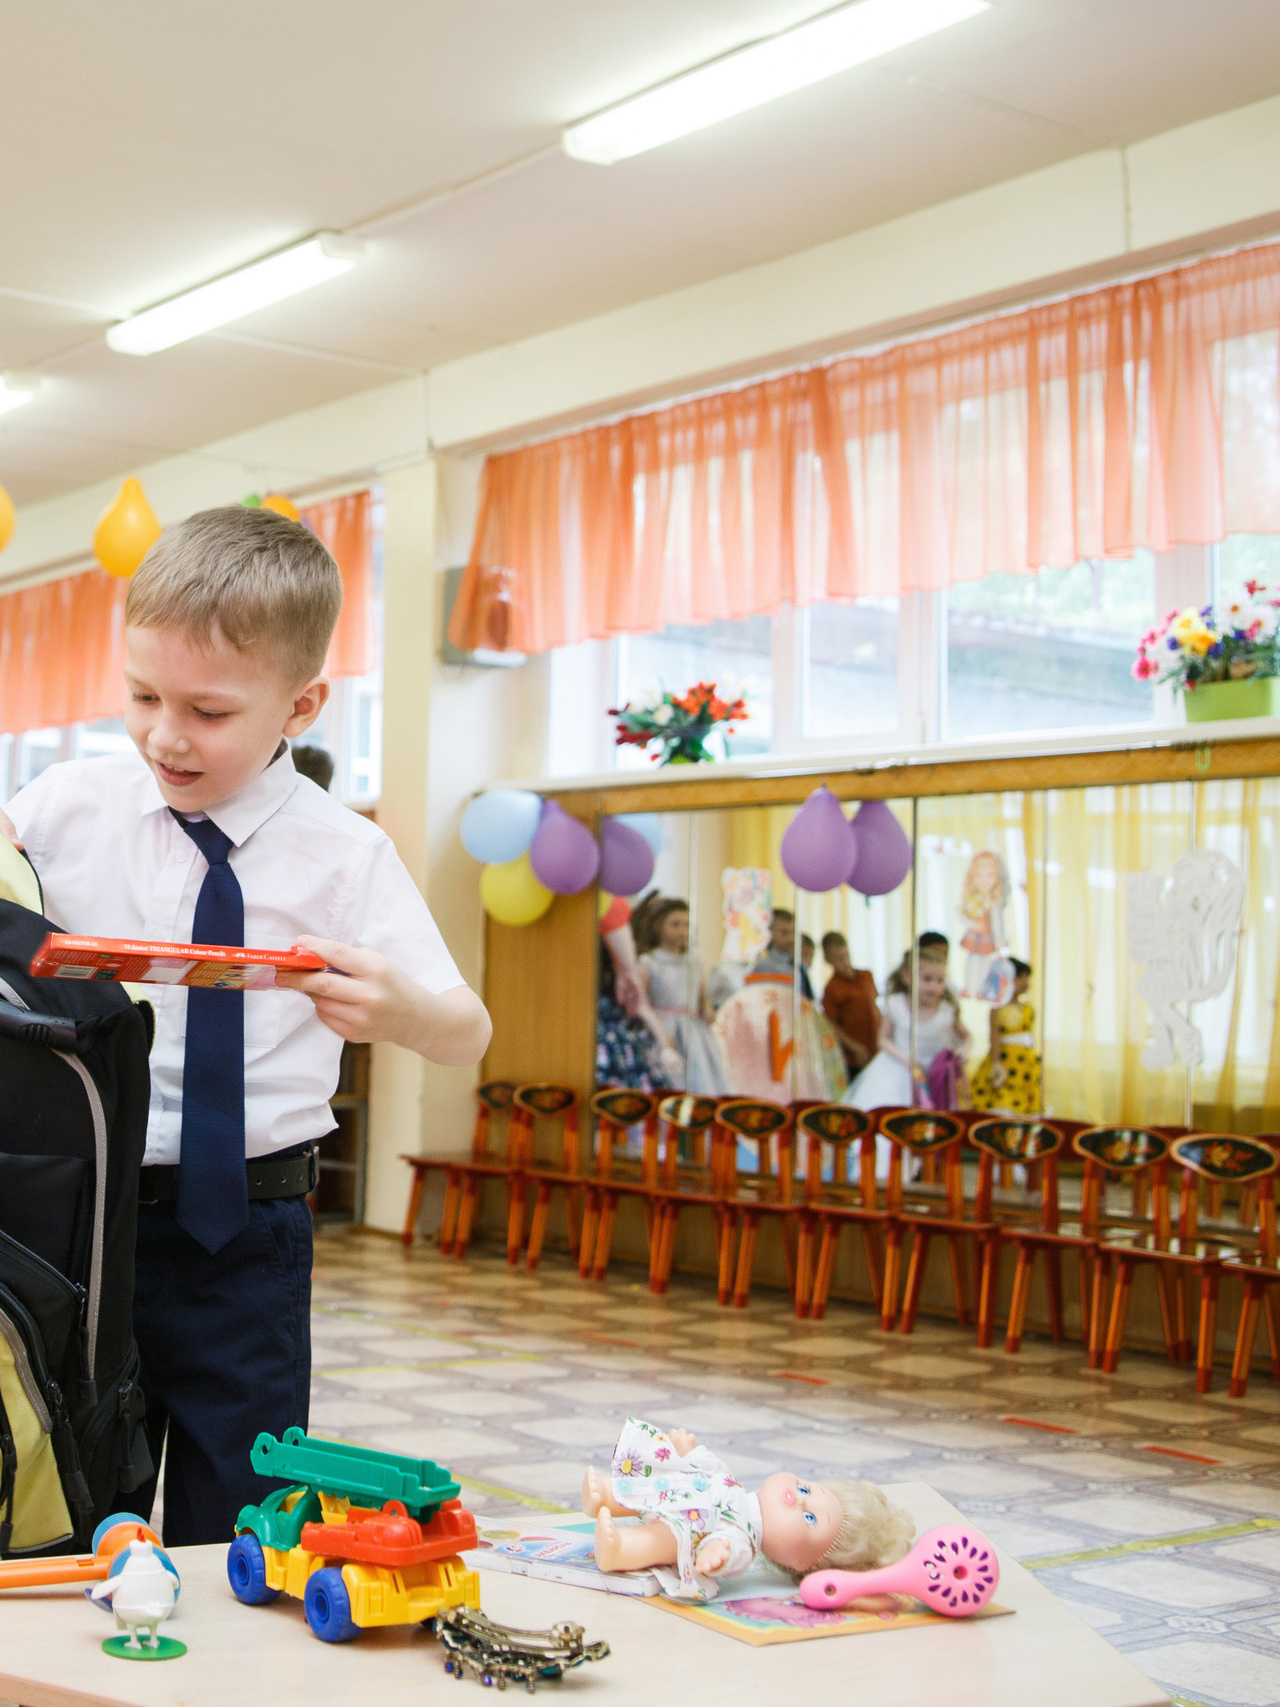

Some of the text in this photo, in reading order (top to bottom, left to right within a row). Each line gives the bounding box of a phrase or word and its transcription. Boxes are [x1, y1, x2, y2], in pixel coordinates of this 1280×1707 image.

[149, 945, 189, 954] TRIANGULAR
[189, 948, 207, 956] Colour
[208, 949, 226, 957] Pencils
